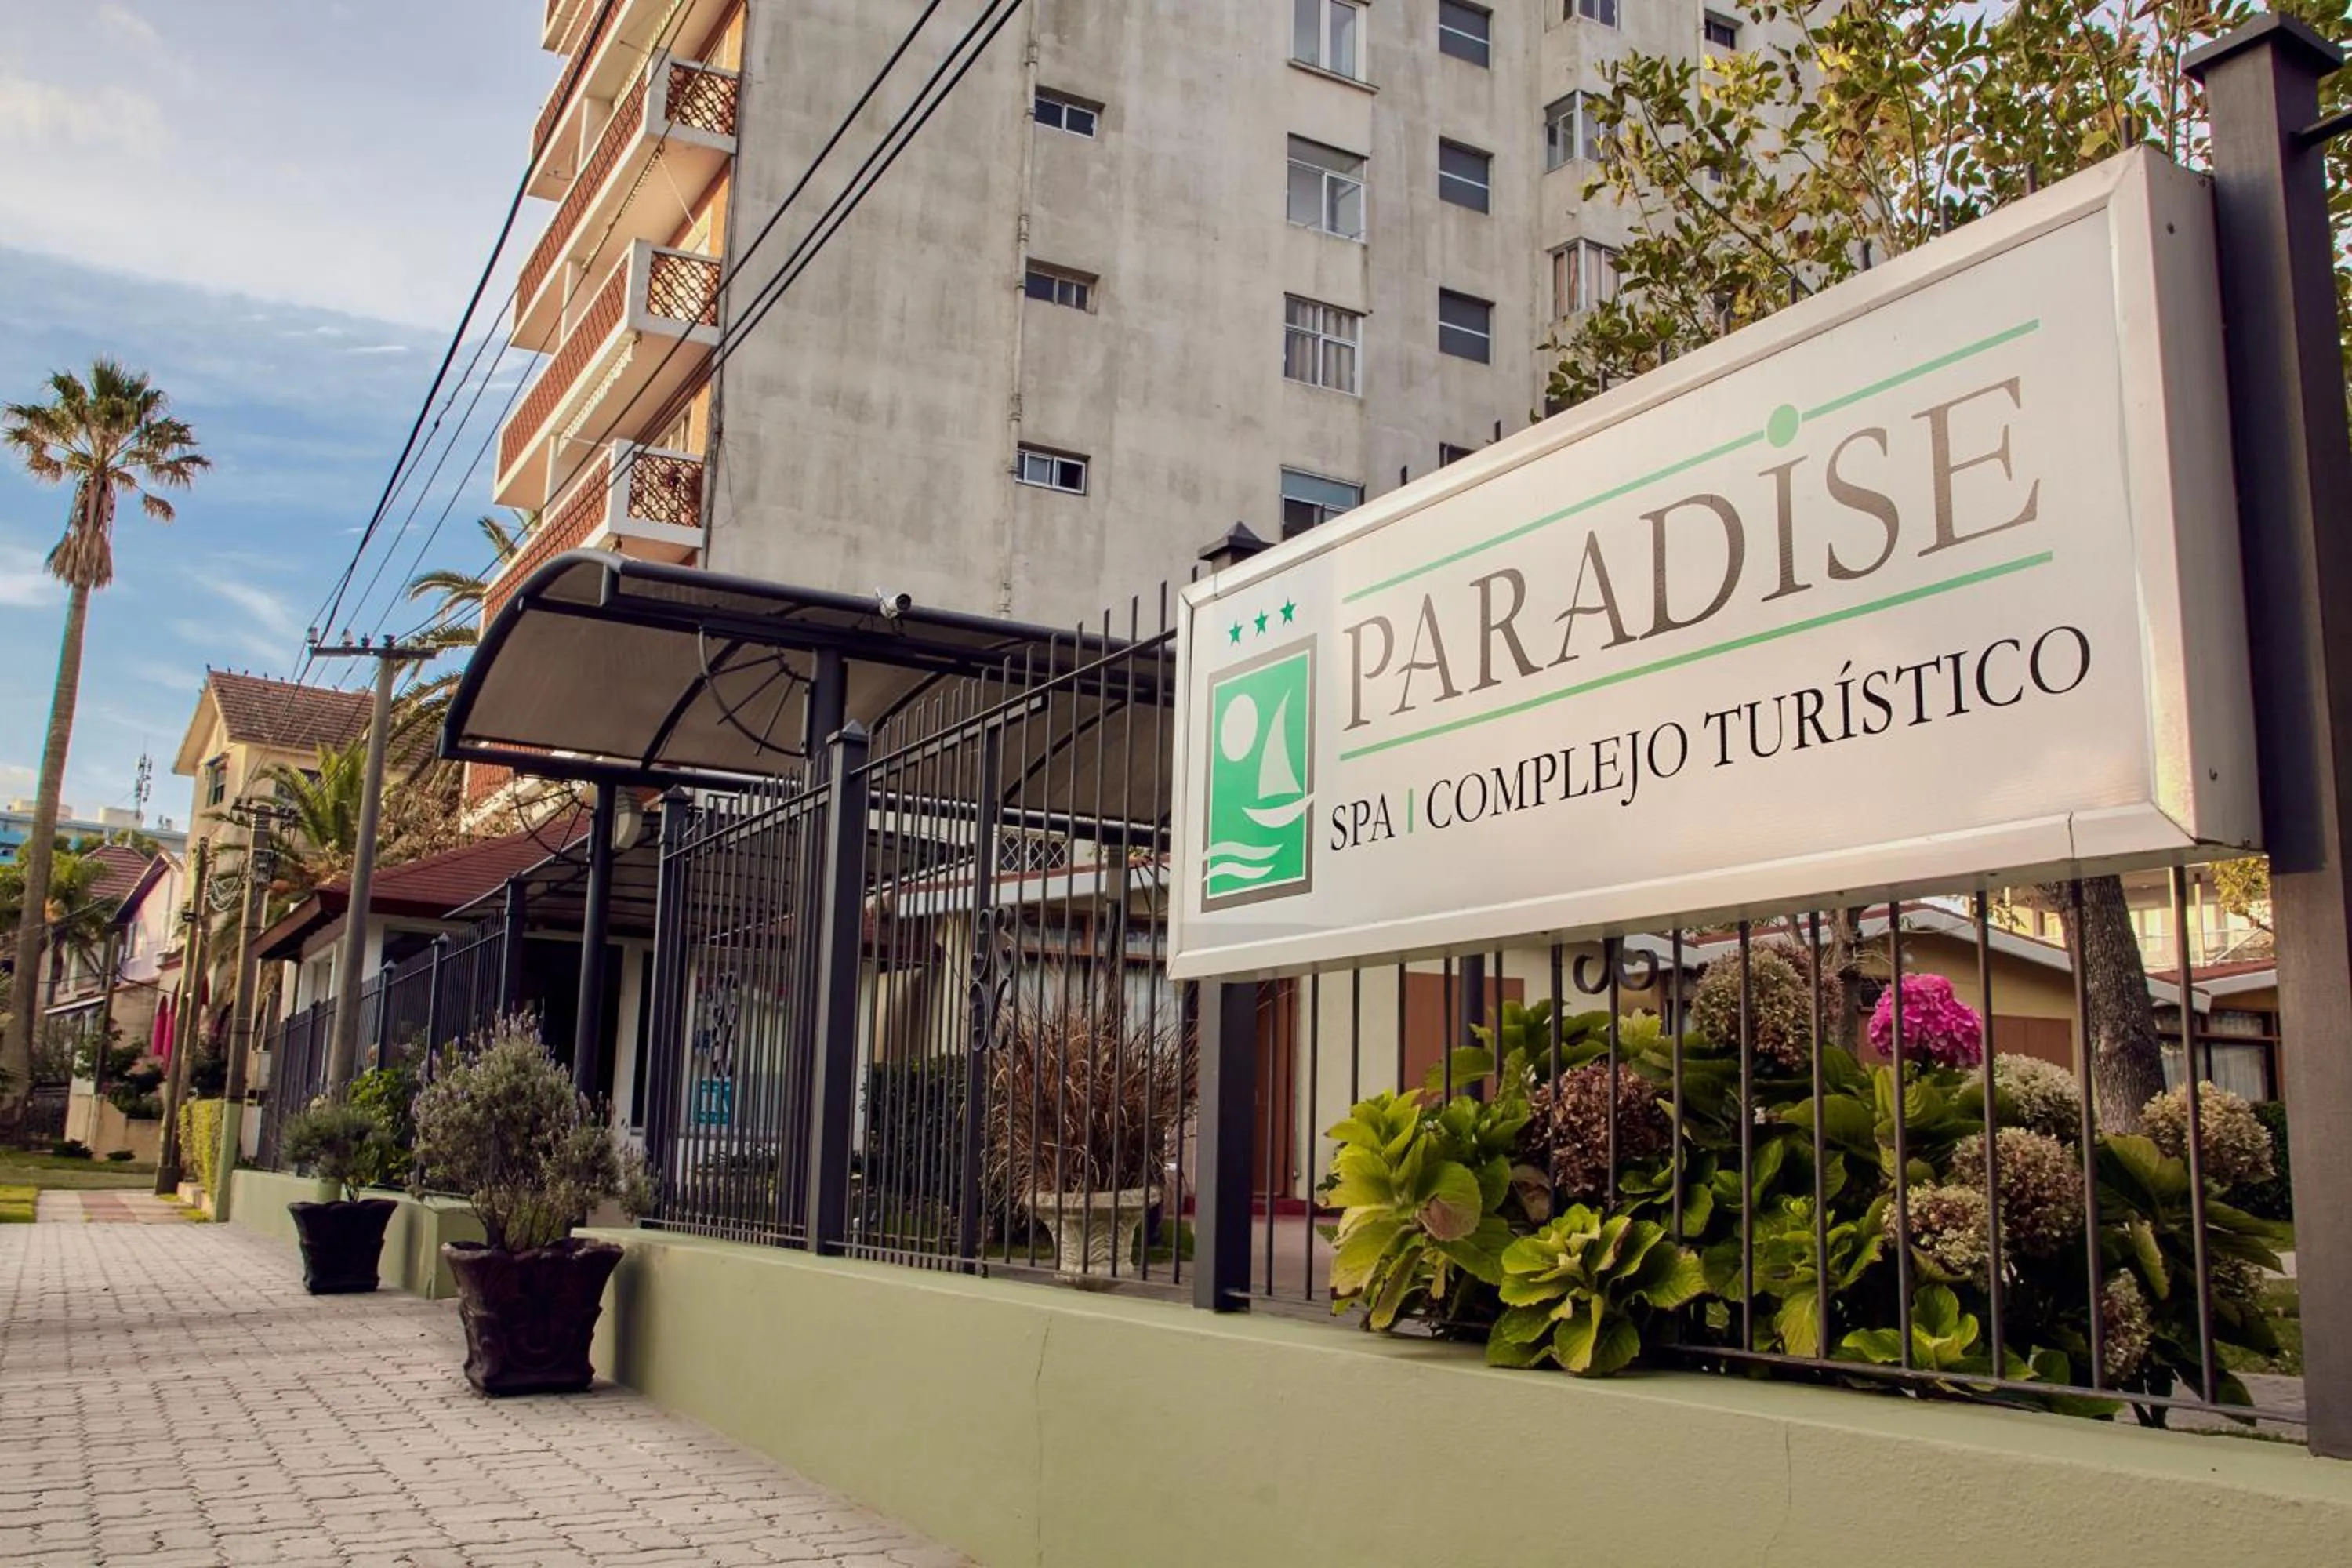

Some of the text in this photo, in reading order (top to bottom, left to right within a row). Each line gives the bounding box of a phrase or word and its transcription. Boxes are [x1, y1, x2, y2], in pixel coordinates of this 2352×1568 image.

[1342, 376, 2040, 732] PARADISE
[1330, 625, 2092, 851] SPA COMPLEJO TURÍSTICO
